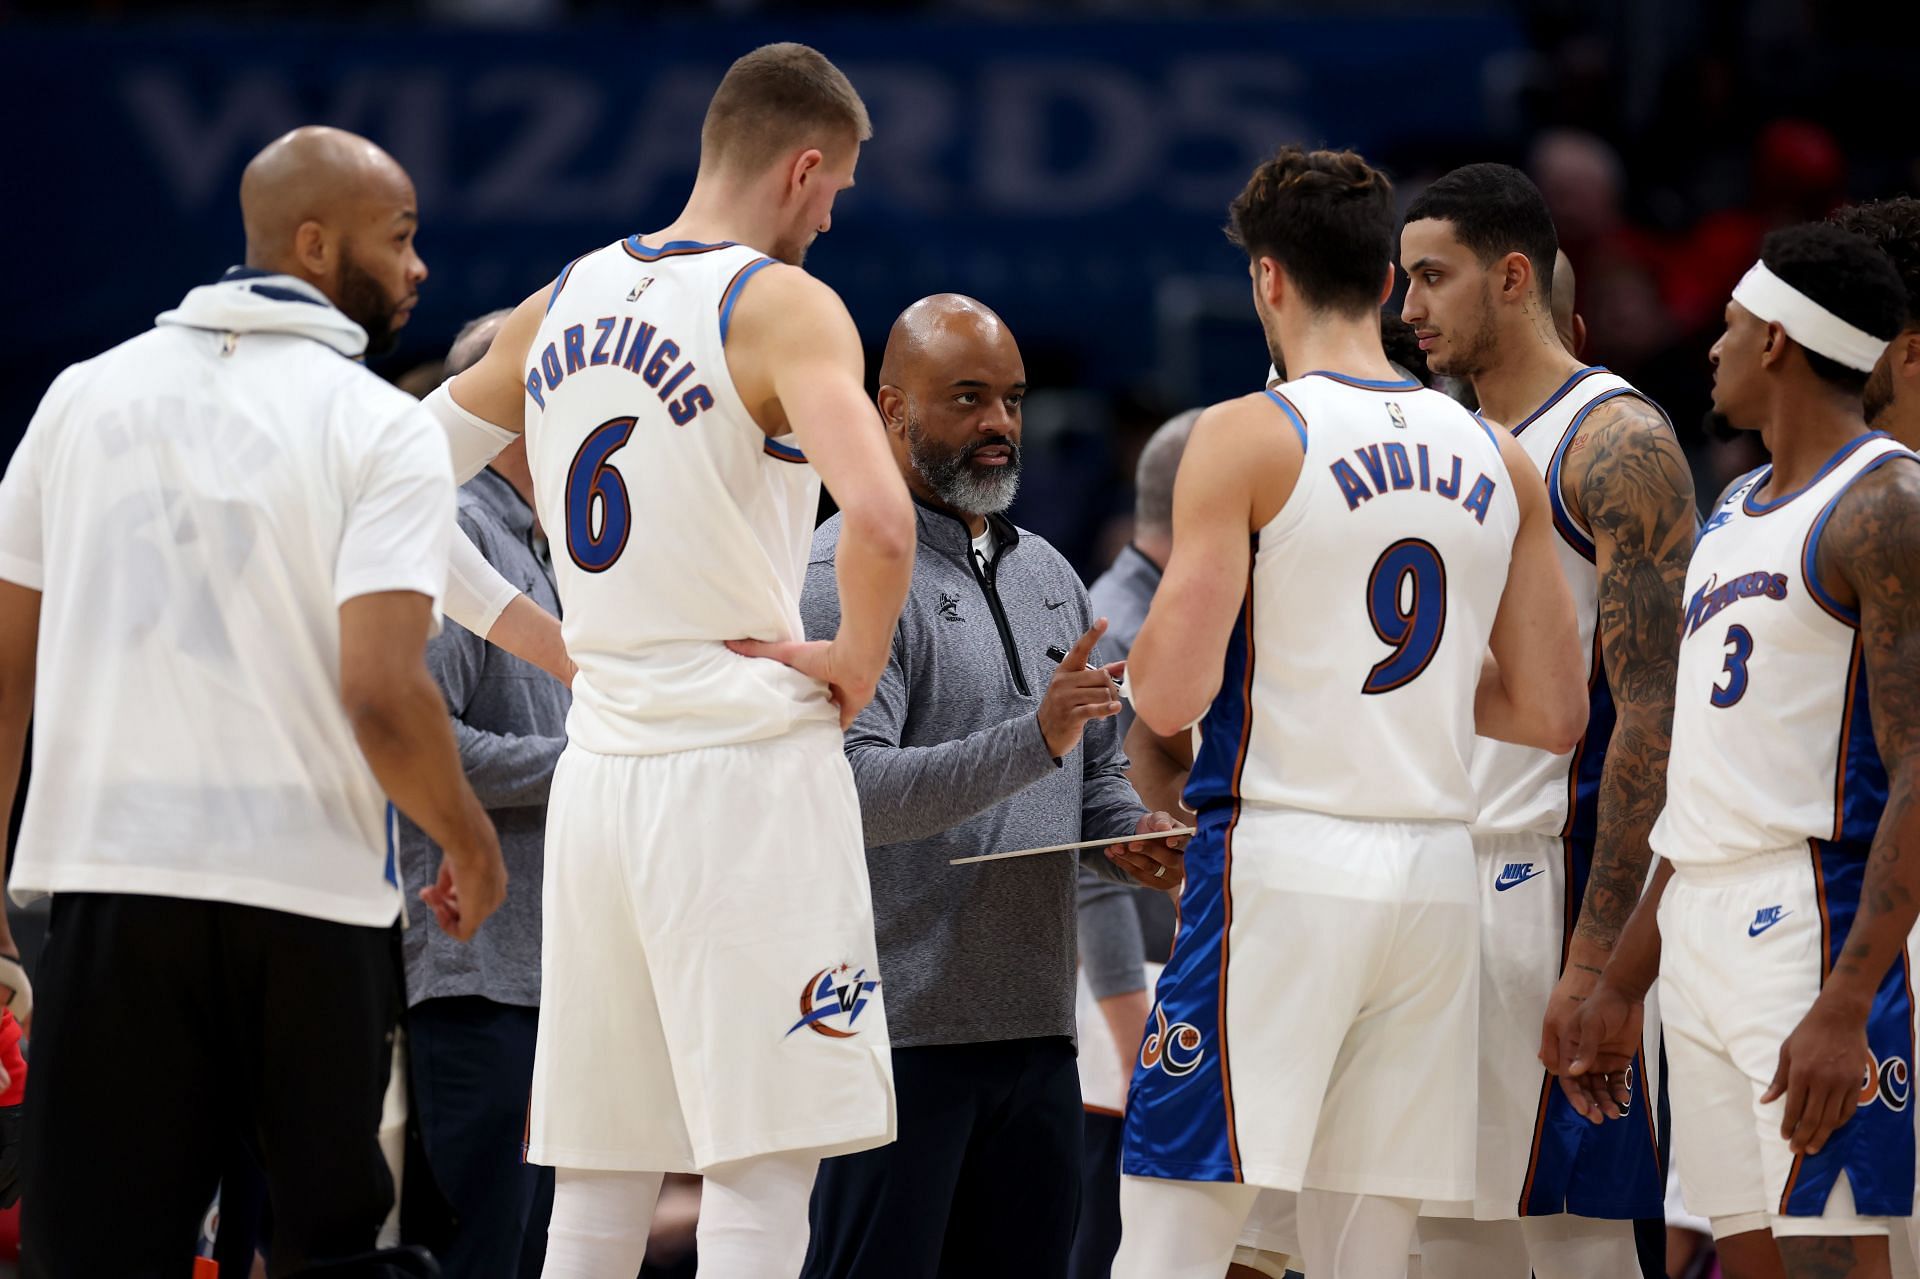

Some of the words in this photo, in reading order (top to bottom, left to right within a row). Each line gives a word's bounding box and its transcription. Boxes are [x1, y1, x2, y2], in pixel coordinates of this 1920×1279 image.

[526, 316, 714, 426] PORZINGIS
[565, 416, 639, 573] 6
[1329, 442, 1496, 526] AVDIJA
[1361, 537, 1447, 695] 9
[1710, 624, 1754, 708] 3
[1501, 863, 1533, 879] NIKE
[1755, 905, 1782, 924] NIKE
